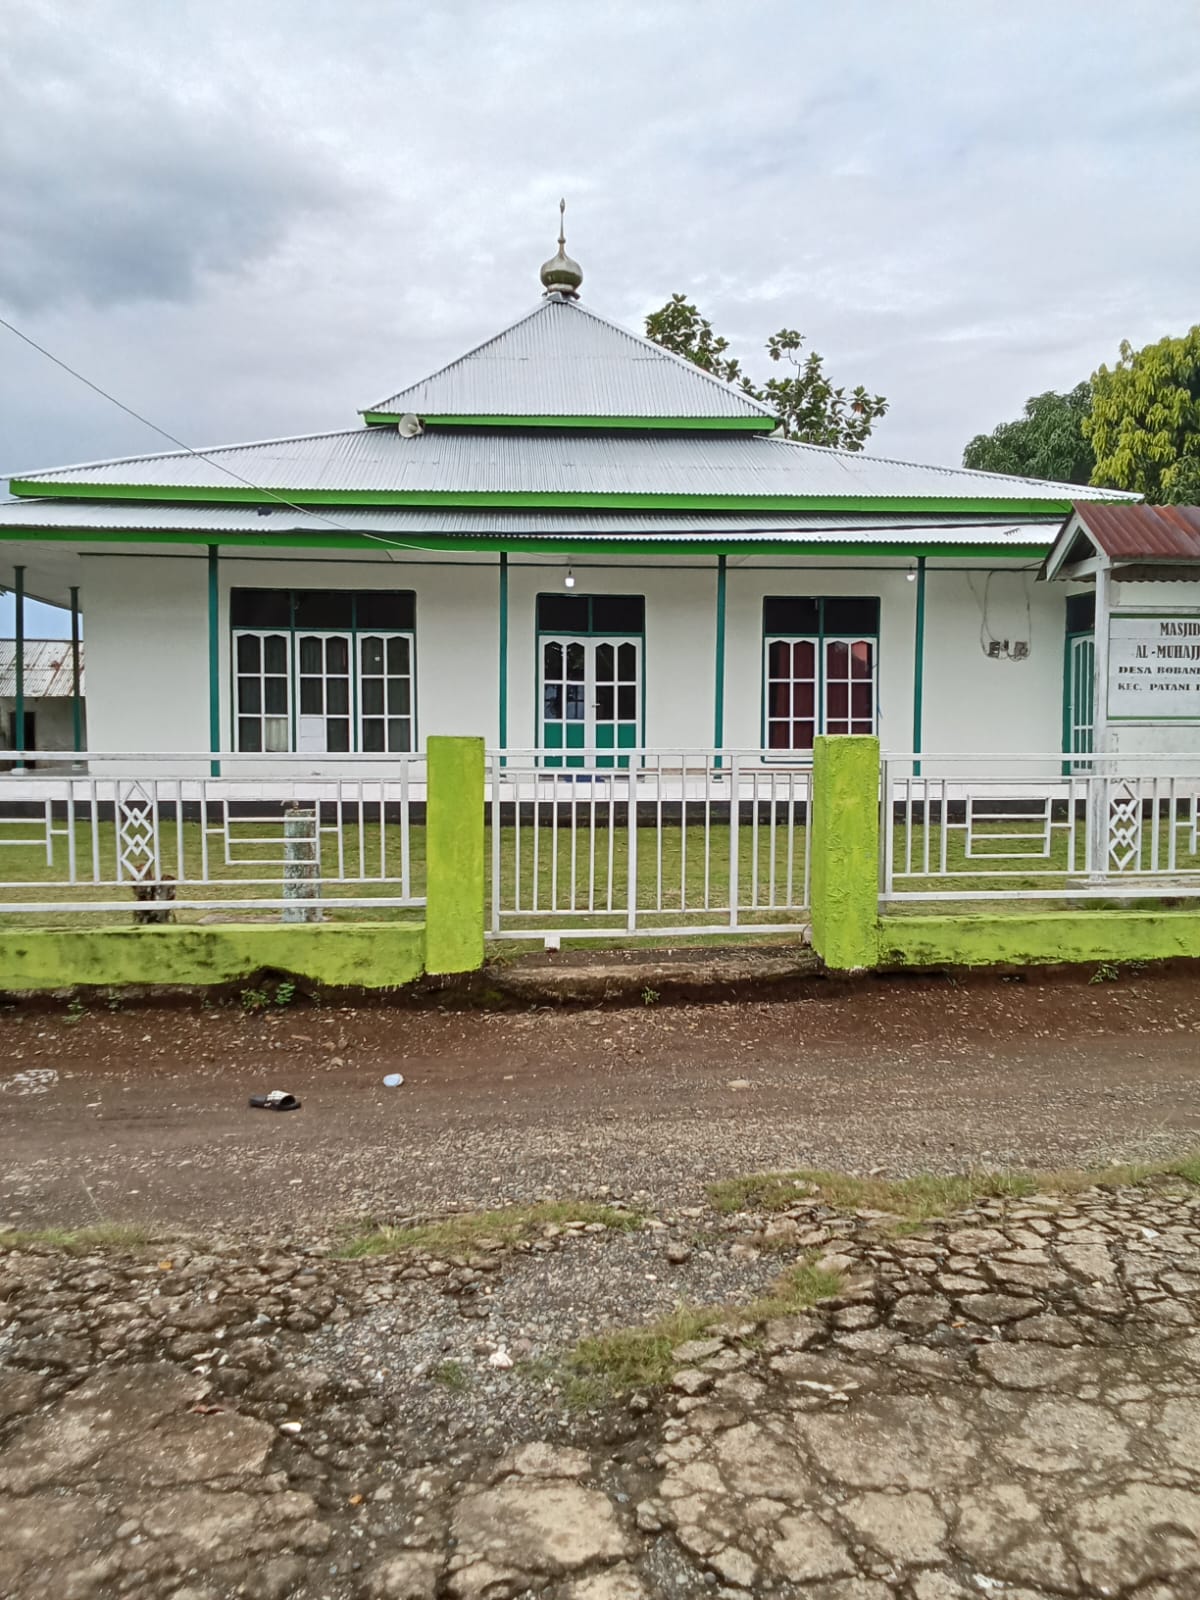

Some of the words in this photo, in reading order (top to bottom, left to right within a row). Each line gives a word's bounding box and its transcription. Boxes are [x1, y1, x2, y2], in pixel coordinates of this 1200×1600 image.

[1160, 622, 1200, 638] MASJID
[1118, 666, 1152, 674] DESA
[1118, 682, 1143, 691] KEC.
[1150, 683, 1190, 691] PATANI
